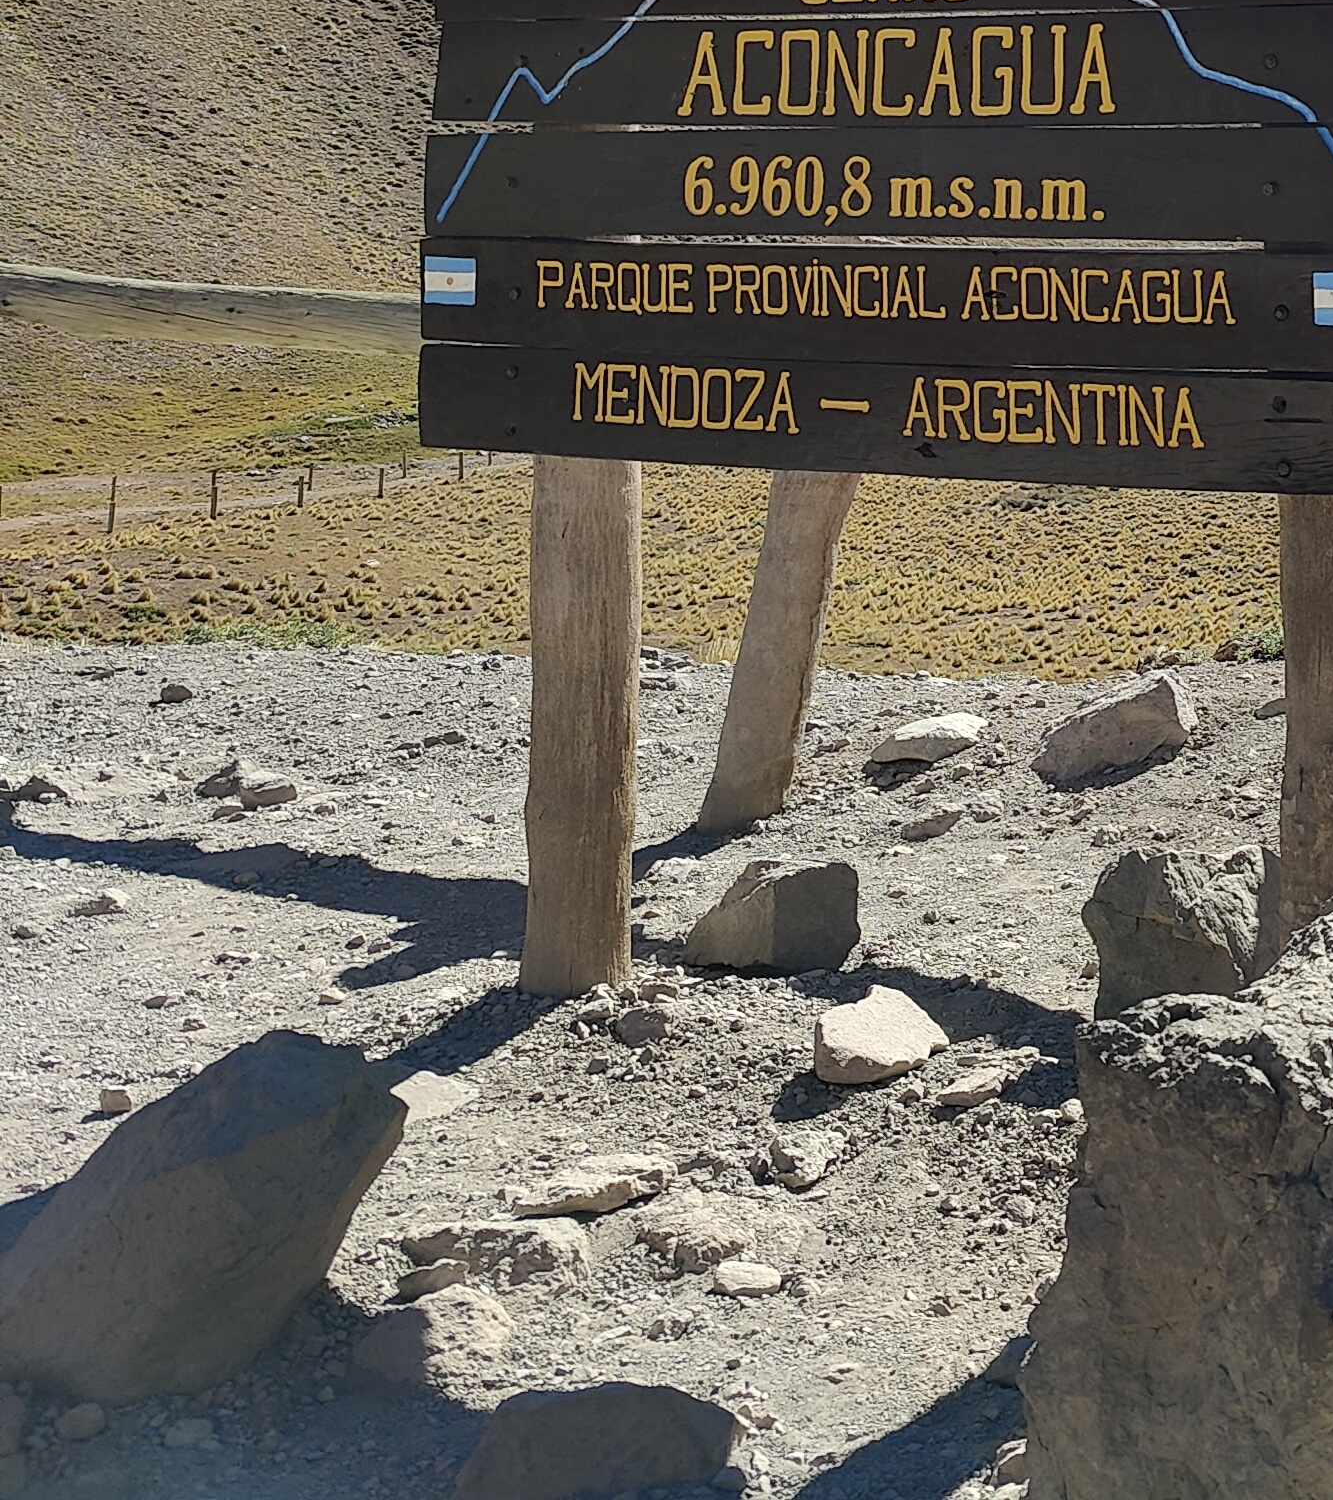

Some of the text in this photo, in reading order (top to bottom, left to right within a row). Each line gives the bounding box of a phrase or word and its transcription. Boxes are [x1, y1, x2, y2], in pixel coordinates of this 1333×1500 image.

[676, 22, 1117, 118] ACONCAGUA
[683, 154, 1106, 226] 6.960,8 m.s.n.m.
[536, 258, 695, 315] PARQUE
[959, 265, 1238, 326] ACONCAGUA
[572, 361, 800, 436] MENDOZA
[901, 375, 1206, 450] ARGENTINA
